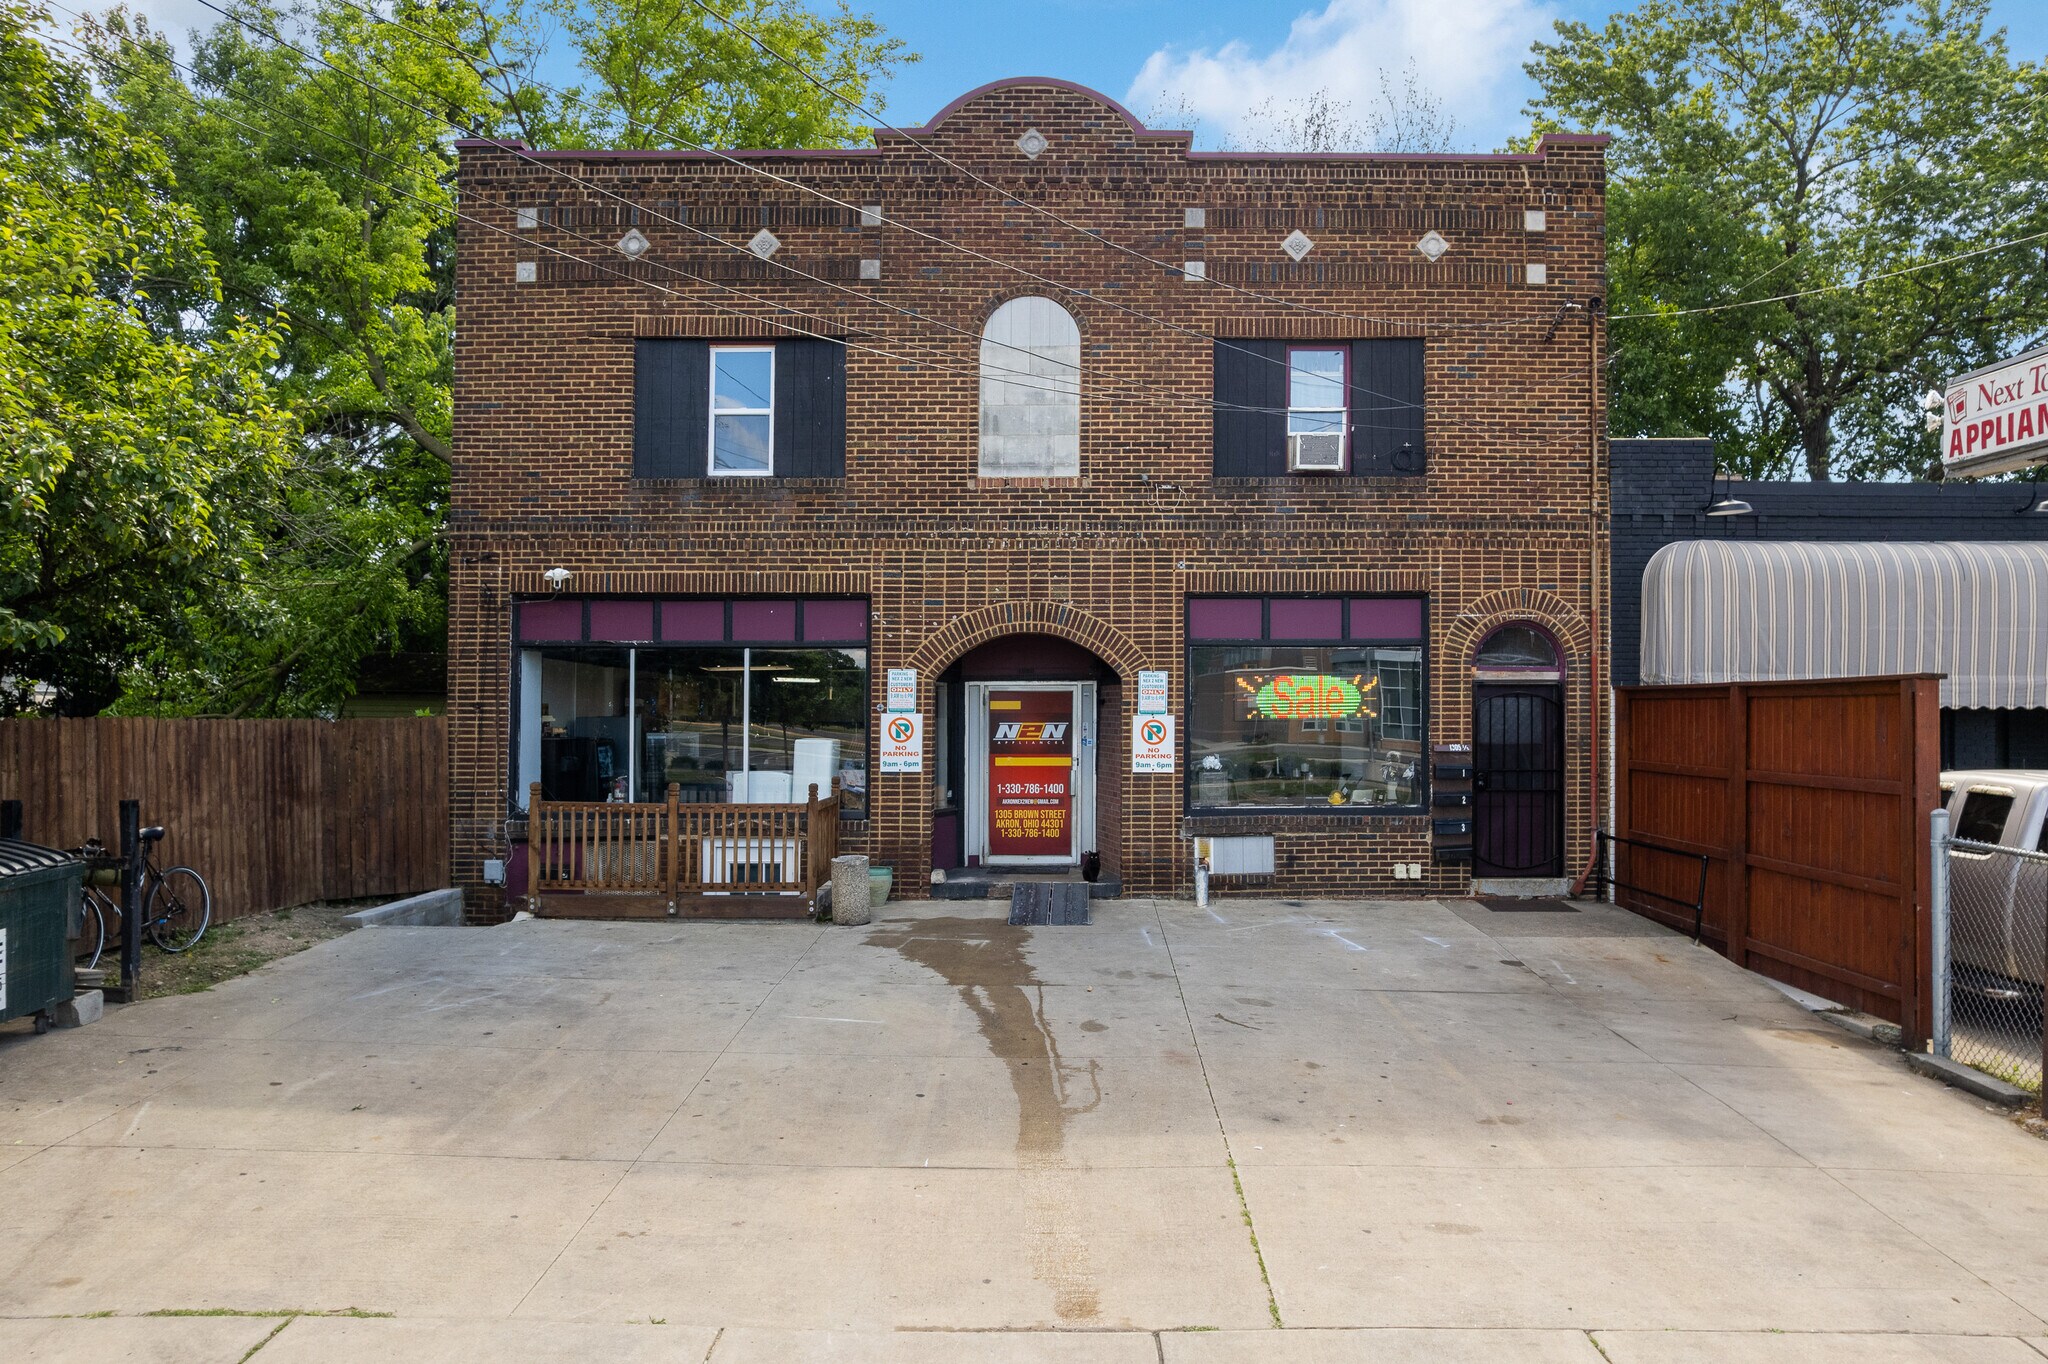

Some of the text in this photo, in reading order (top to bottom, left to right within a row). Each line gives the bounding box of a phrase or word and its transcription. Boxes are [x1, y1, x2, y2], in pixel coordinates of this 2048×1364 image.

[1977, 377, 2024, 411] Next
[1272, 675, 1344, 719] Sale
[993, 722, 1069, 741] N2N
[997, 783, 1064, 794] 1-330-786-1400
[1462, 795, 1467, 804] 2
[995, 809, 1066, 819] 1305 BROWN STREET
[995, 819, 1064, 829] AKRON, OHIO 44301
[1461, 823, 1466, 832] 3
[1001, 828, 1060, 838] 1-330-786-1400
